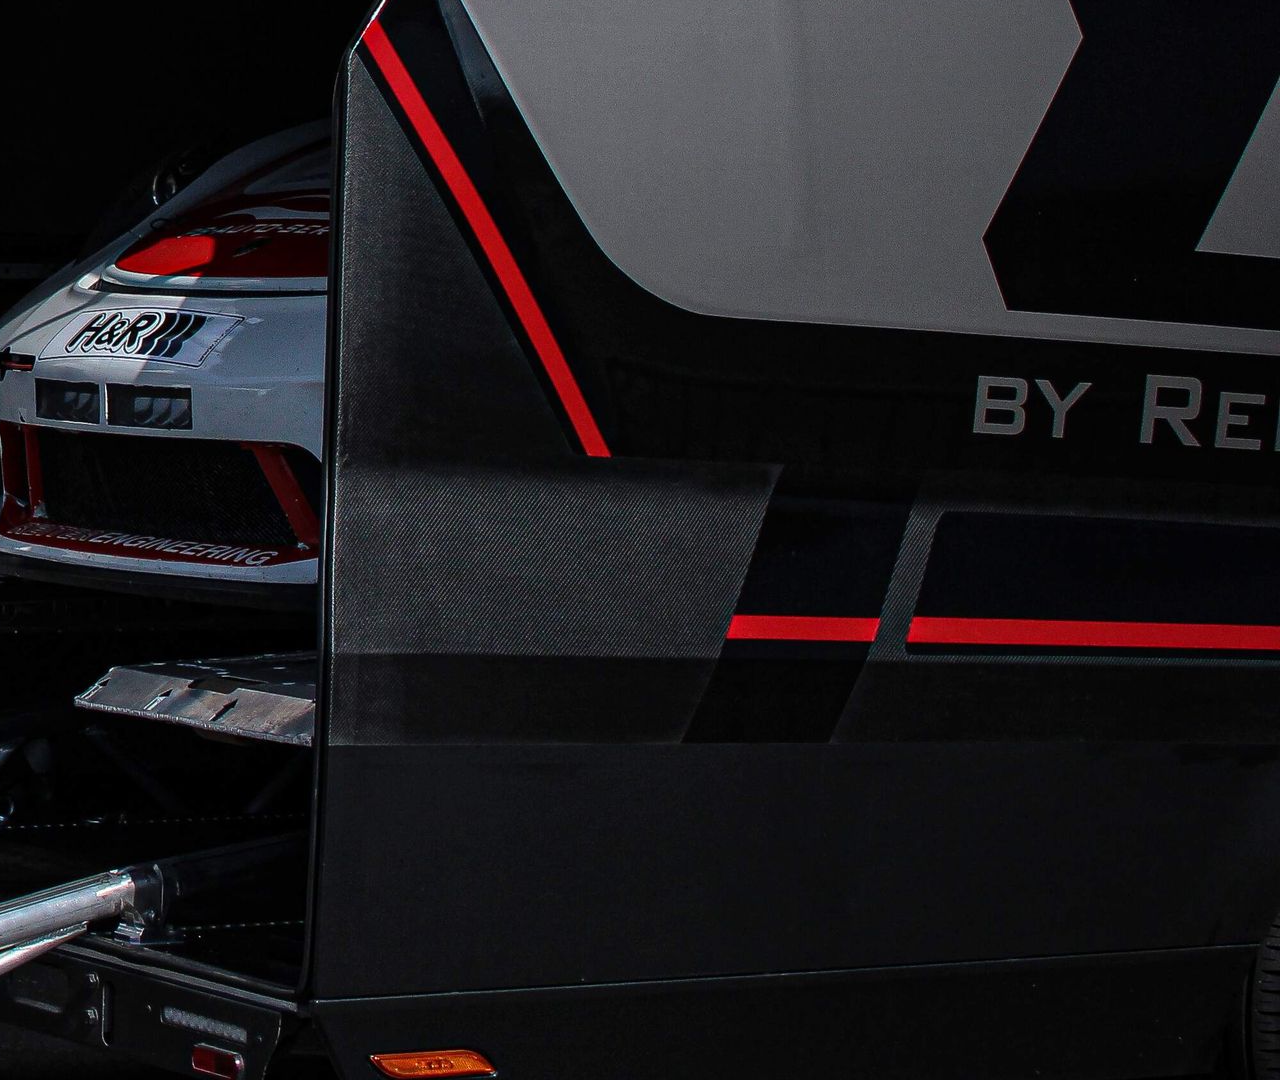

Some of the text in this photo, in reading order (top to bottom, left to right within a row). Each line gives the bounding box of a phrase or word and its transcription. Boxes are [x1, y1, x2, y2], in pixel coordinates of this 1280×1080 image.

[65, 311, 162, 355] H&R
[973, 375, 1093, 439] BY
[89, 531, 280, 566] ENGINEERING
